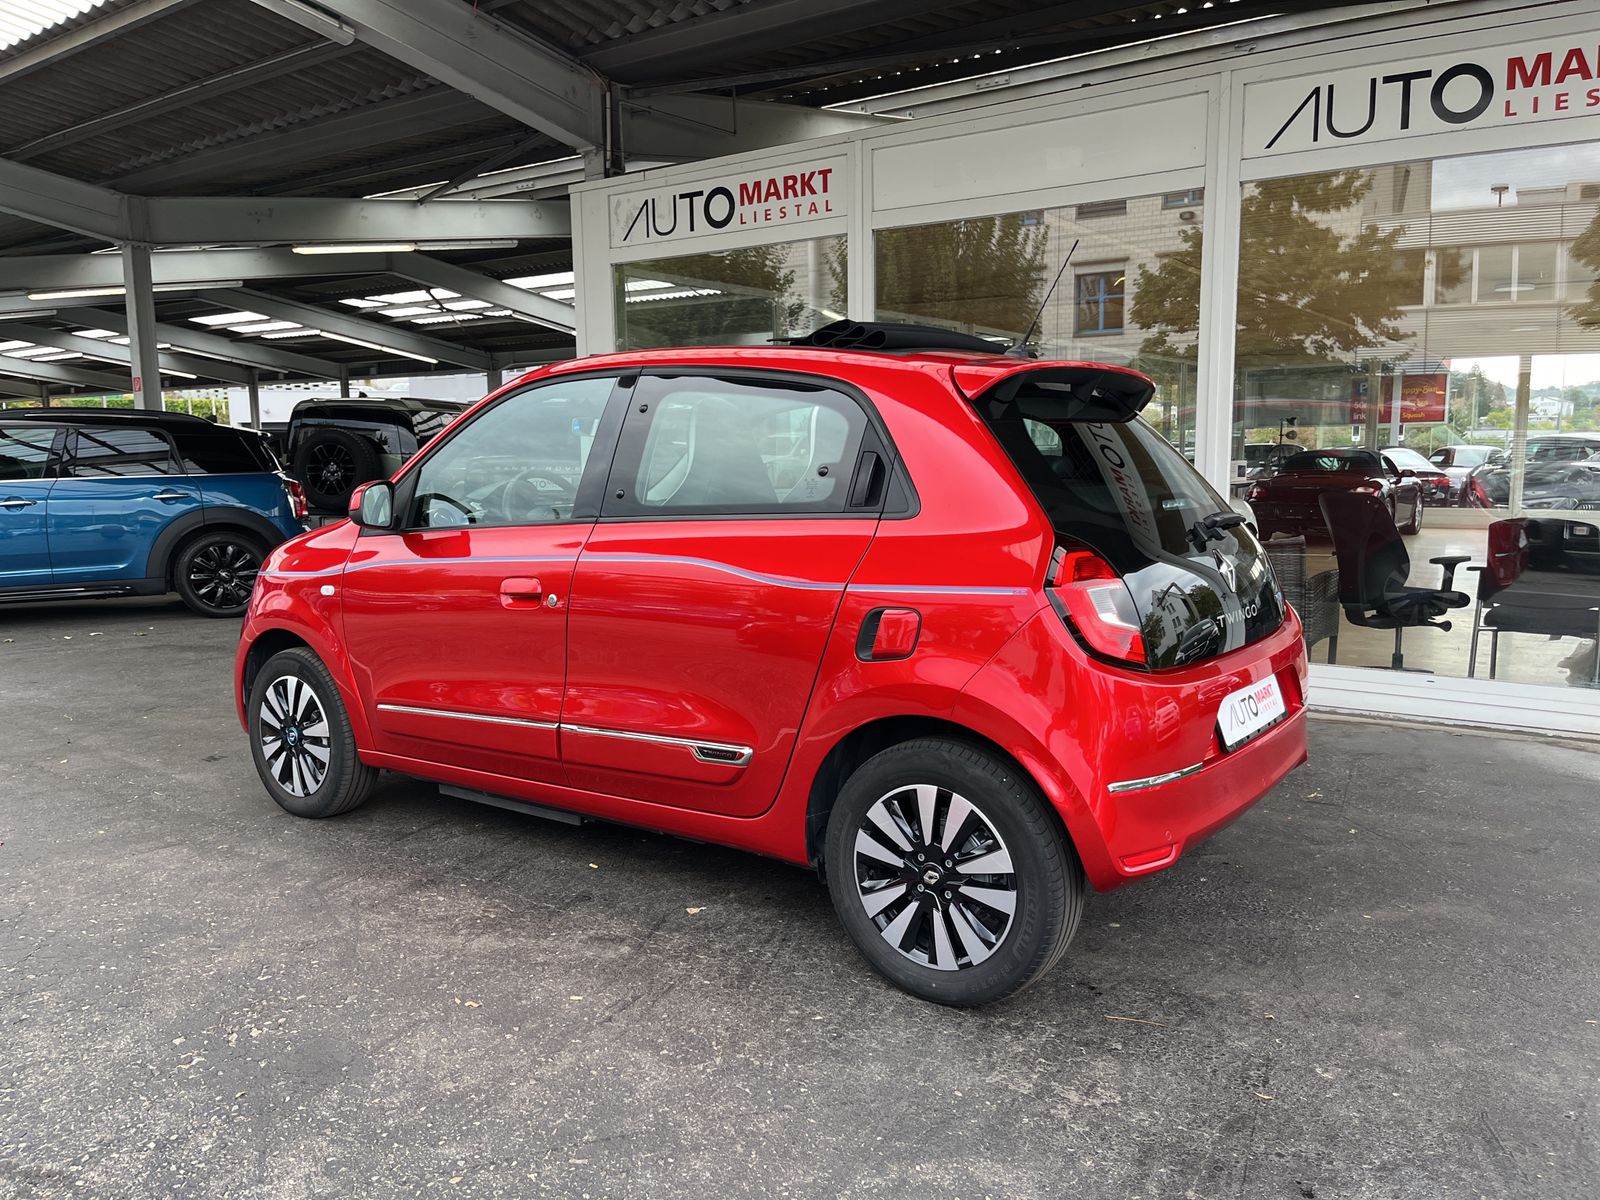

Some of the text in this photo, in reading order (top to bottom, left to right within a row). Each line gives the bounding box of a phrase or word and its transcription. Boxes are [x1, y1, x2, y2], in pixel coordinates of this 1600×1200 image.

[1264, 44, 1600, 150] AUTO MA
[1503, 88, 1600, 117] LIES
[622, 168, 833, 242] AUTO MARKT
[739, 199, 833, 225] LIESTAL
[1216, 603, 1258, 628] TWINGO
[1229, 682, 1274, 732] AUTO MARKT
